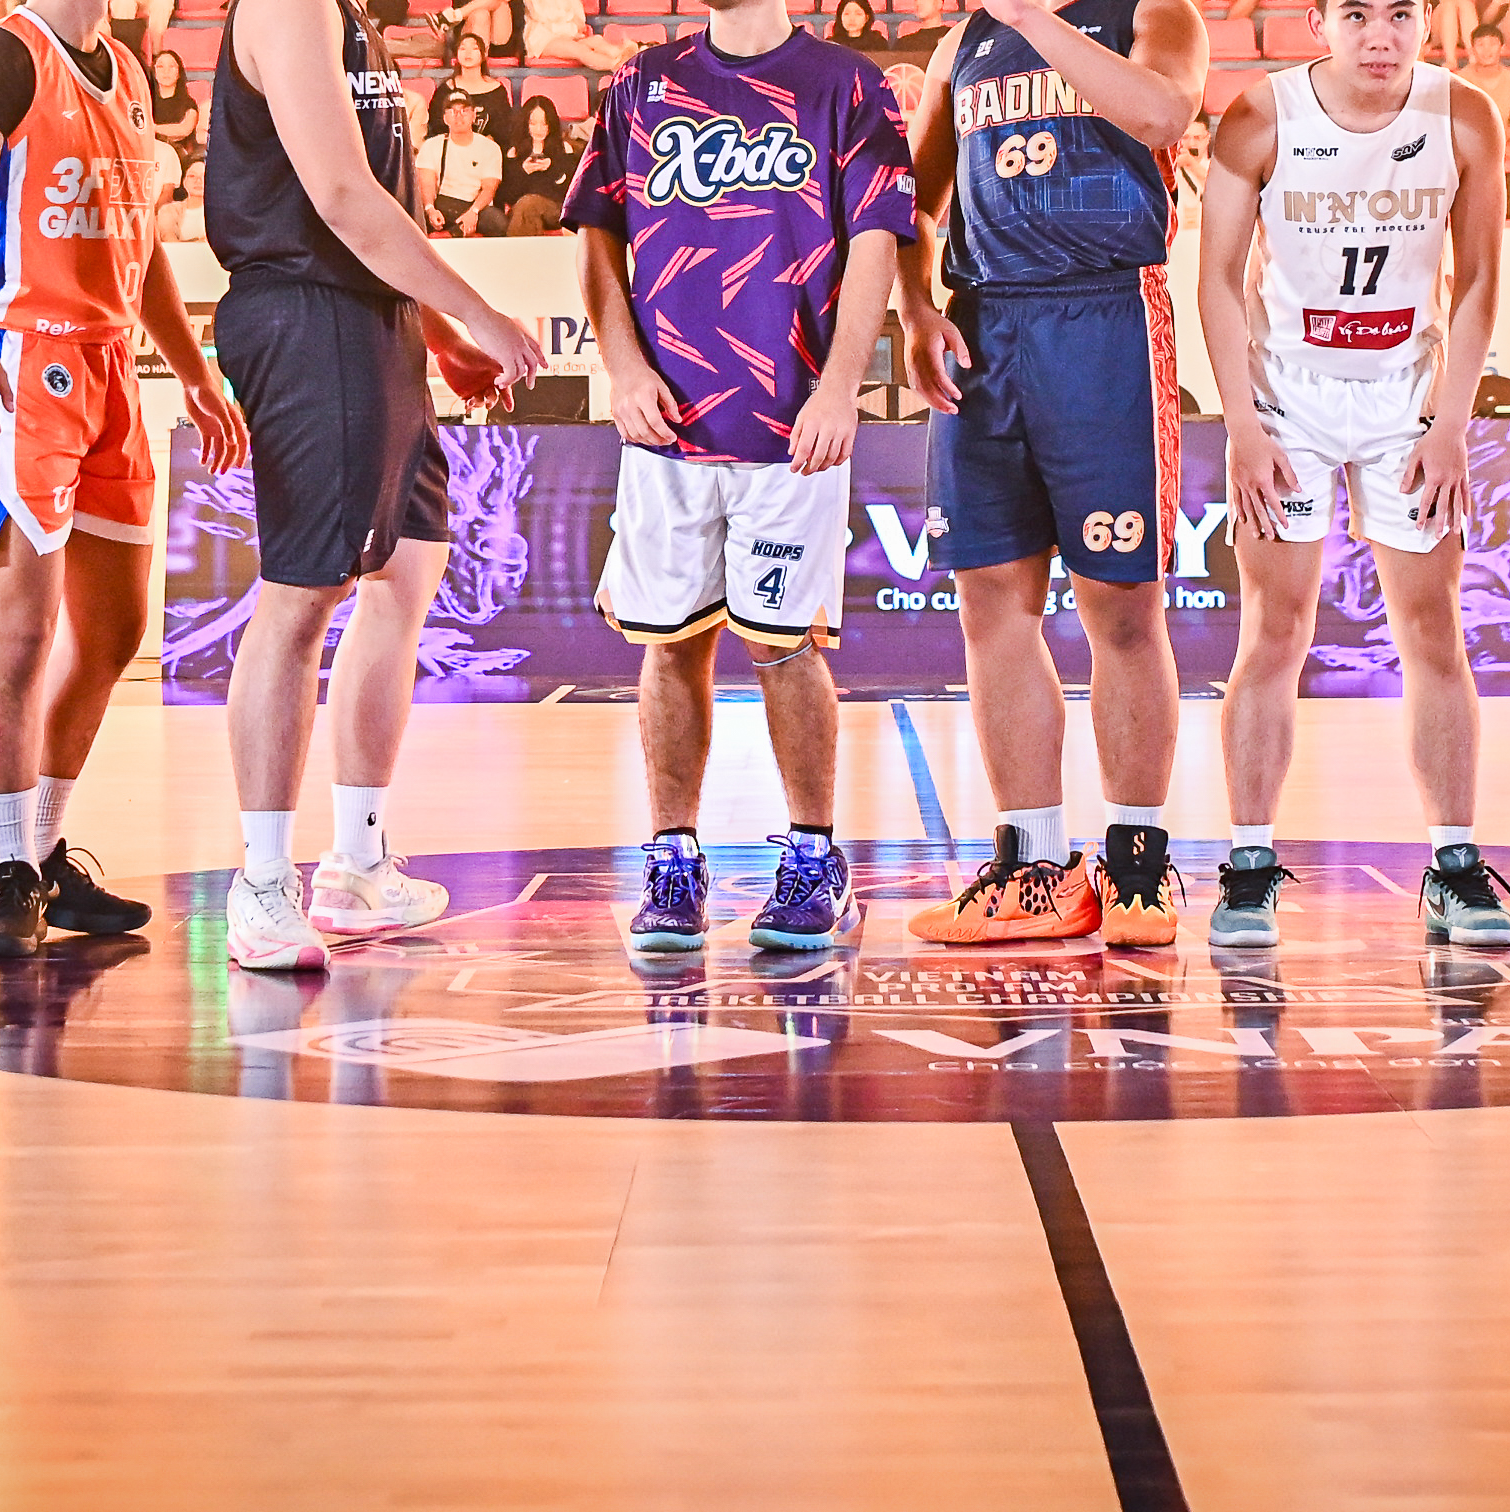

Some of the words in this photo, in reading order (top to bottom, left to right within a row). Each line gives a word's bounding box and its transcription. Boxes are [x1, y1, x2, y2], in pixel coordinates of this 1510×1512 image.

[955, 68, 1094, 139] BADIN
[995, 131, 1058, 179] 69
[38, 206, 151, 241] GALAXY
[1339, 245, 1390, 296] 17
[751, 539, 804, 562] HOOPS
[1082, 510, 1146, 553] 69
[753, 564, 788, 610] 4
[876, 587, 927, 611] Cho
[862, 970, 1088, 982] VIETNAM
[623, 993, 940, 1006] BASKETBALL
[955, 990, 1349, 1005] CHAMPIONSHIP
